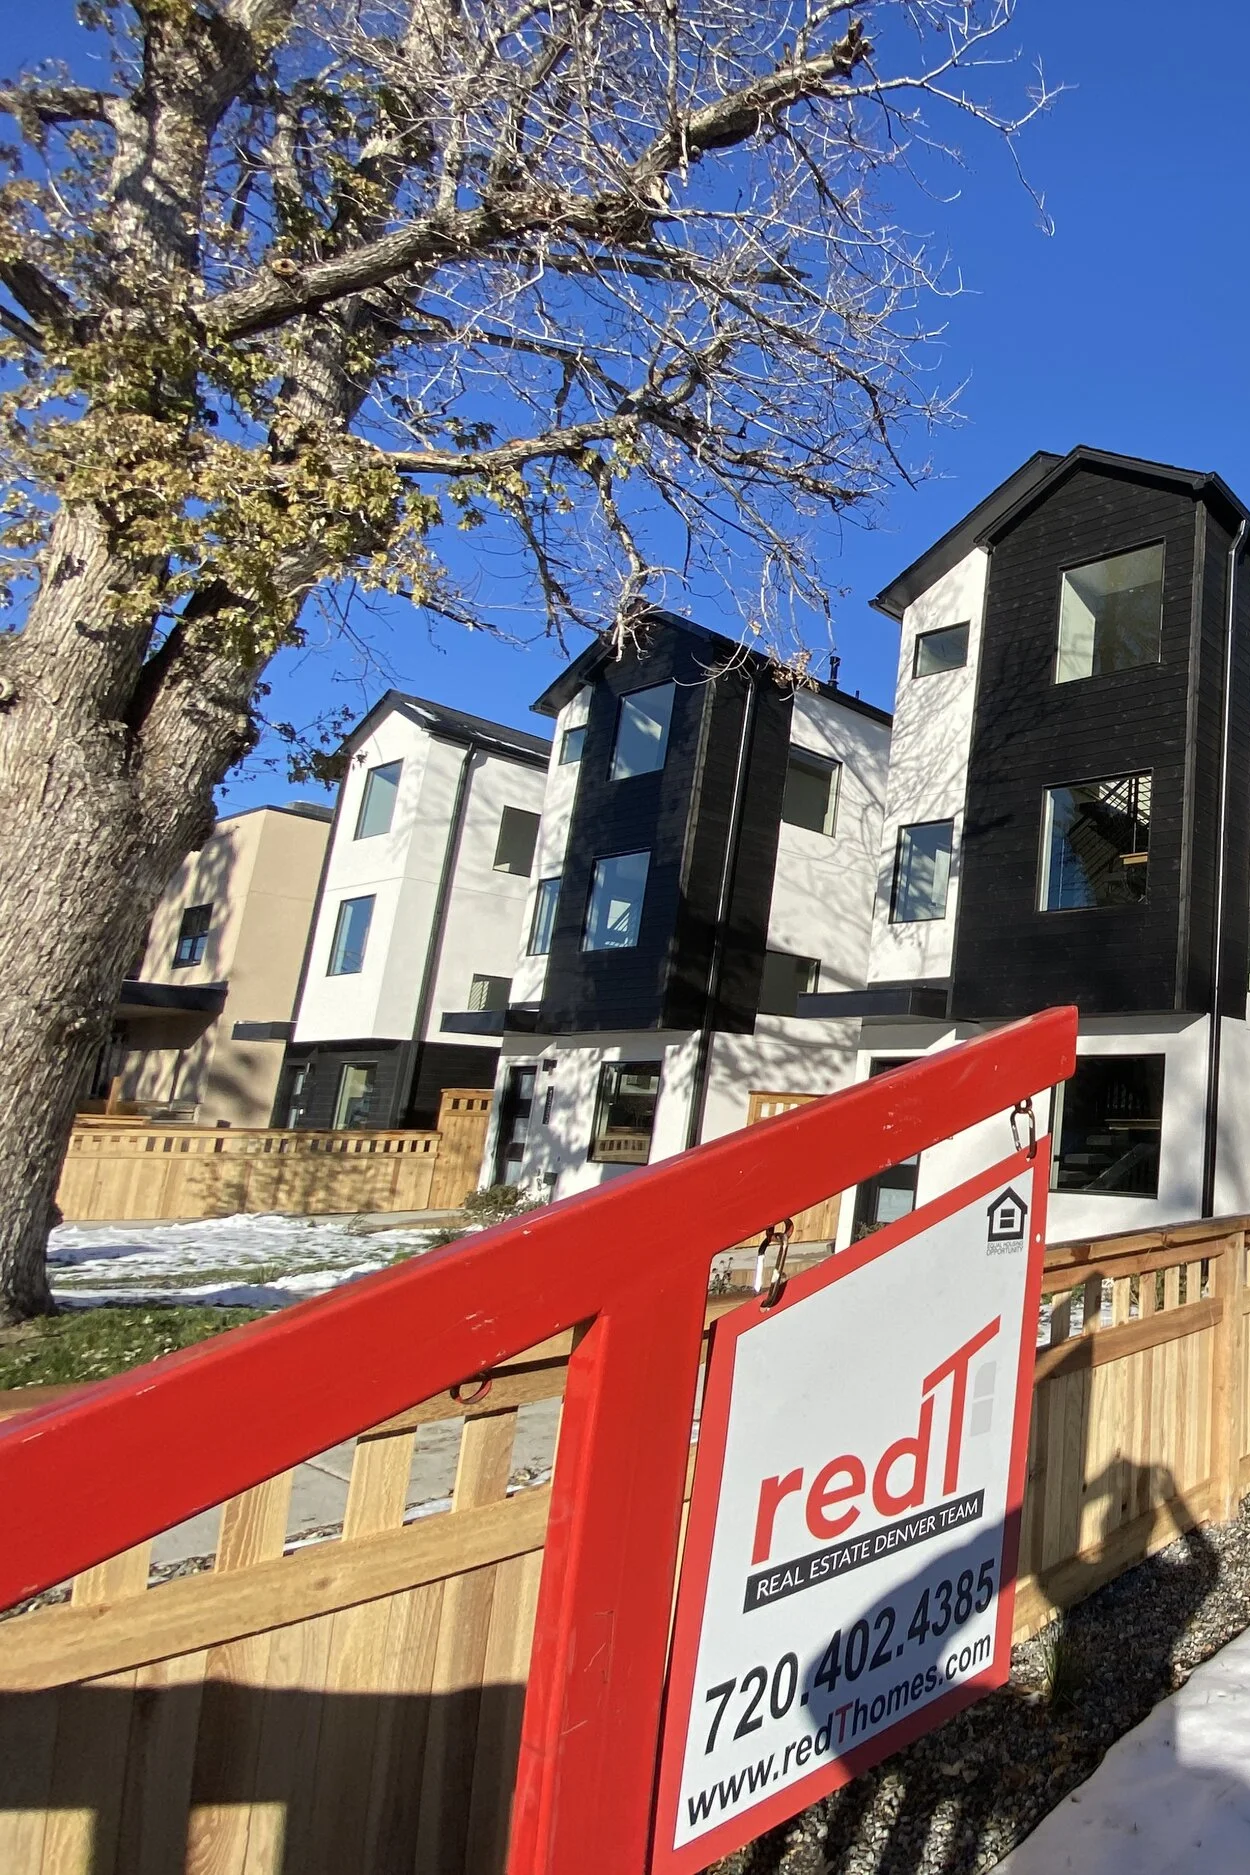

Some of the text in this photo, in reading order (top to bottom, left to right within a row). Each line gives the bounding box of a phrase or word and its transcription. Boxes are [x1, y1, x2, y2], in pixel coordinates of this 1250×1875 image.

[986, 1246, 1024, 1256] OPPORTUNITY
[751, 1314, 1001, 1566] redT
[756, 1498, 979, 1600] REAL ESTATE DENVER TEAM
[688, 1633, 991, 1827] www.redThomes.com
[704, 1558, 995, 1756] 720.402.4385
